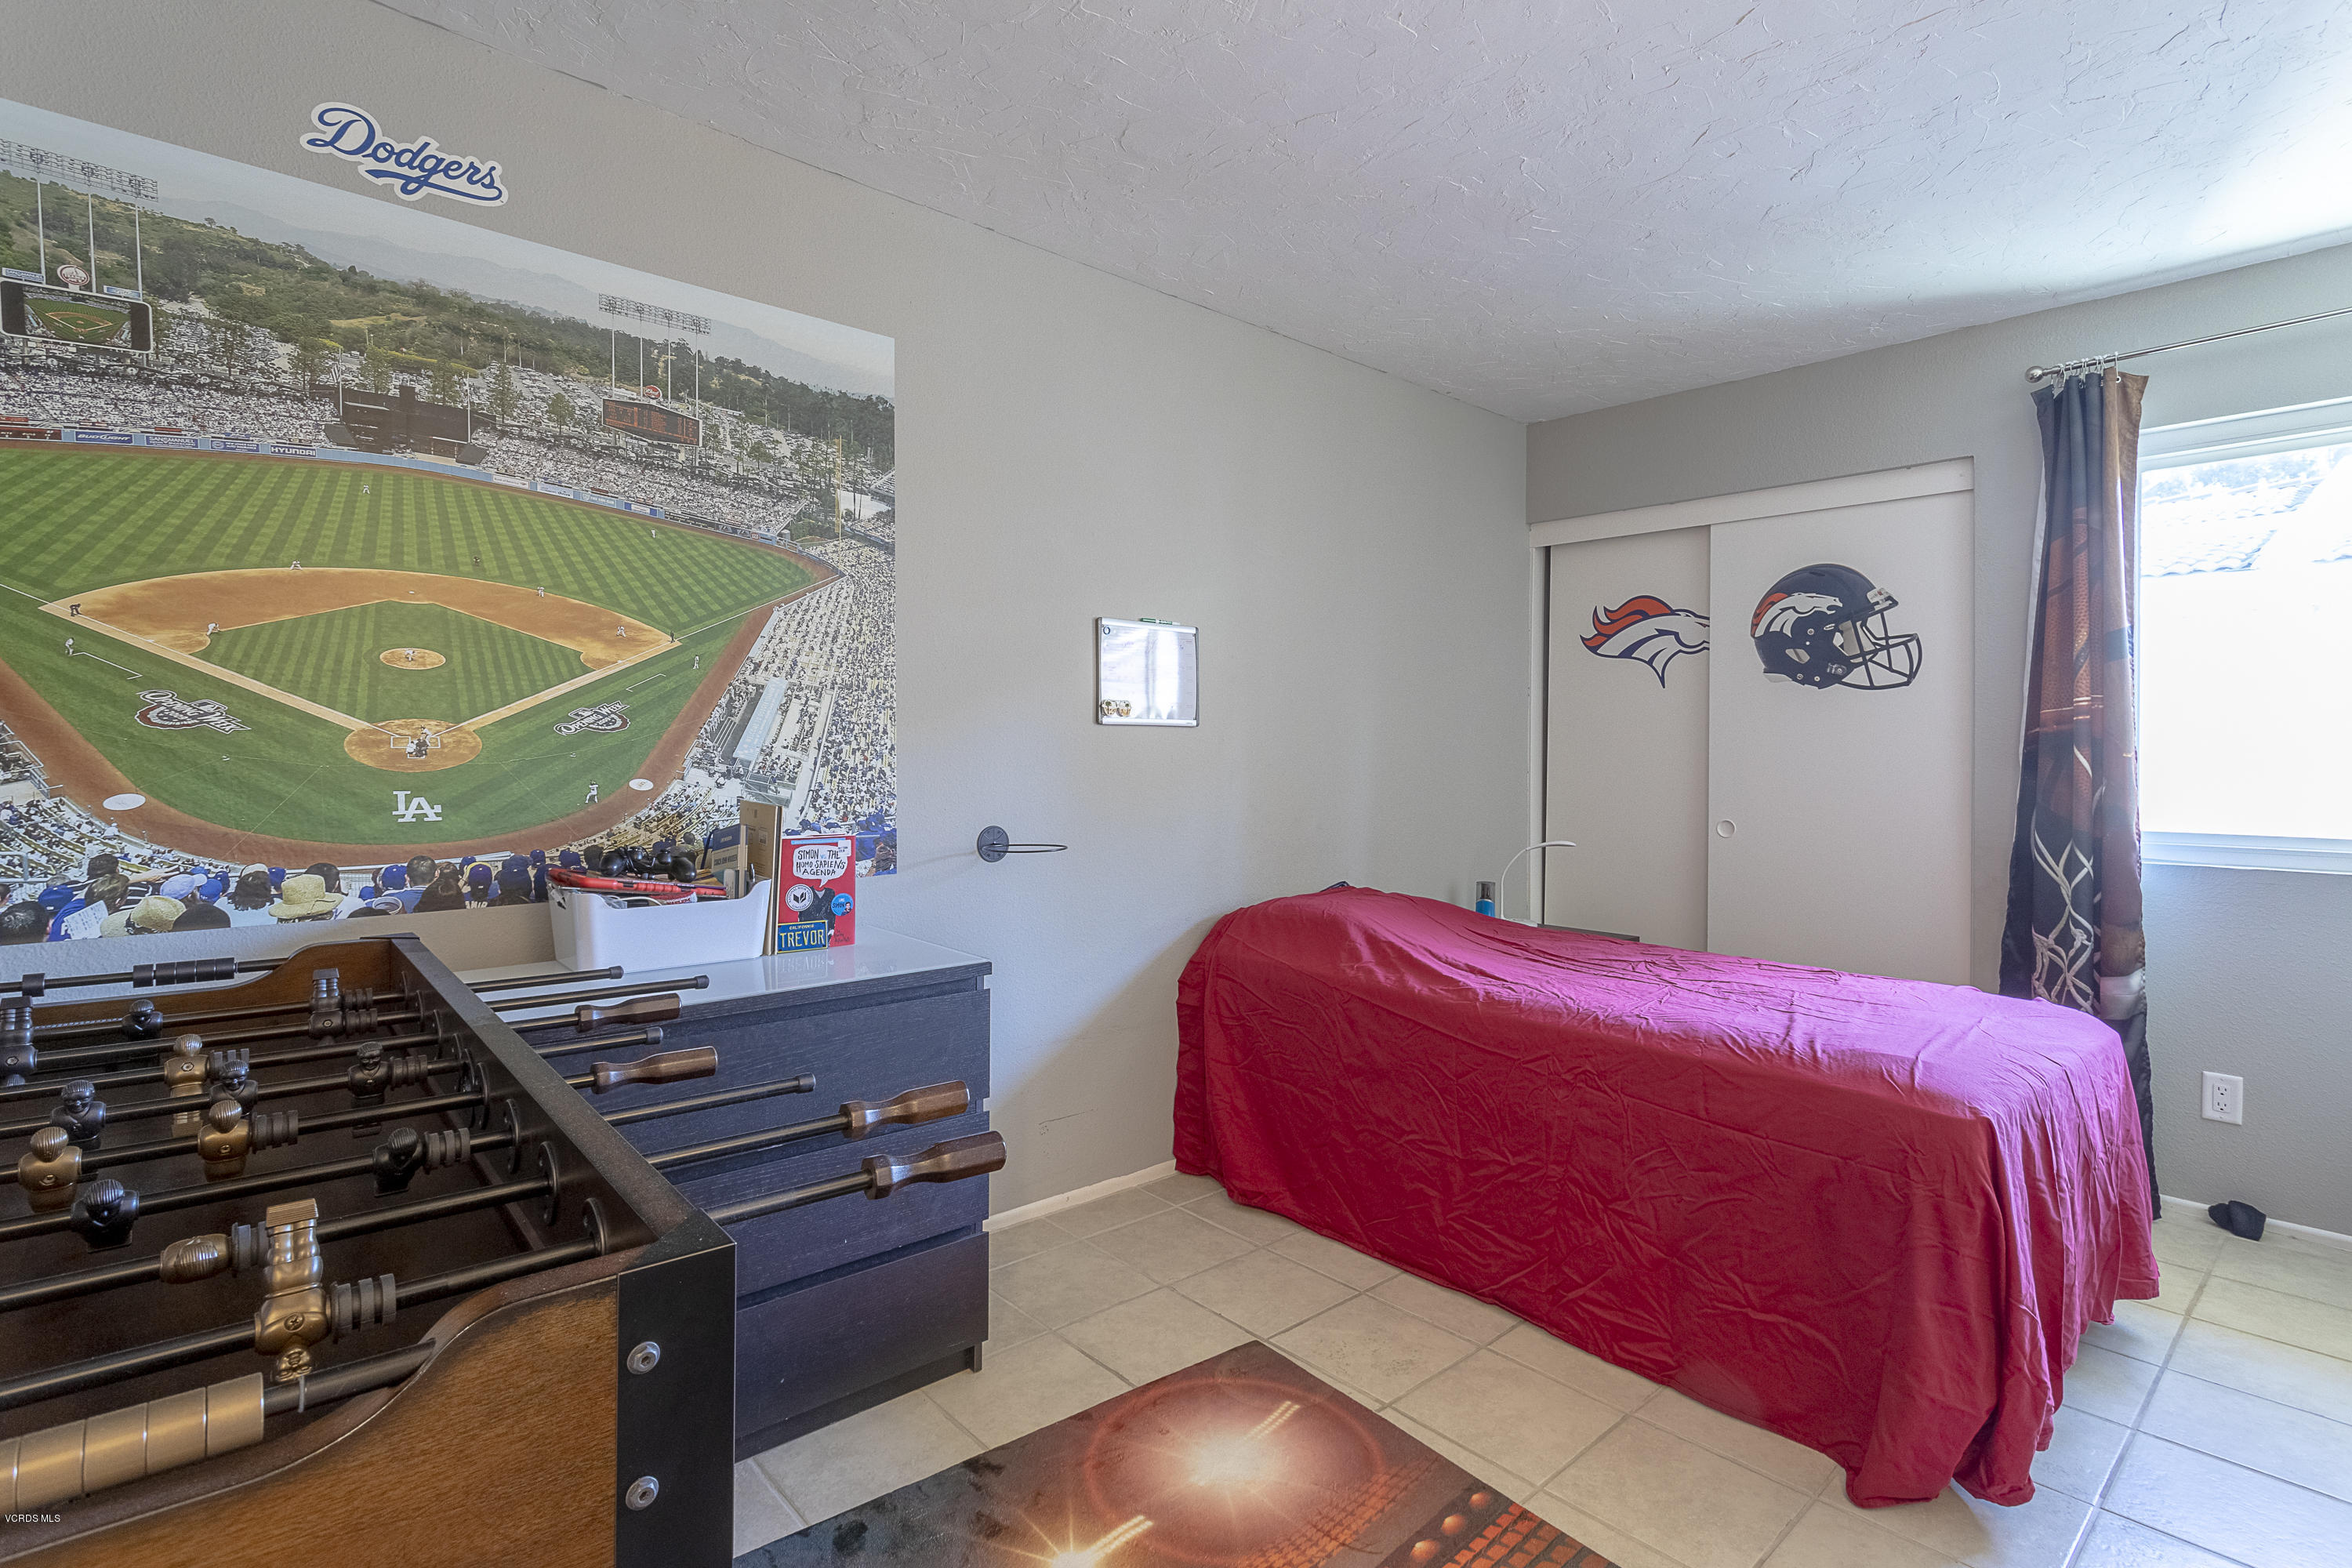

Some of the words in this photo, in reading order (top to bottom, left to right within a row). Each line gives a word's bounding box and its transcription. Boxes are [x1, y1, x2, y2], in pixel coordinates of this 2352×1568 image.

[307, 108, 503, 201] Dodgers
[271, 446, 315, 456] HYUNDAI
[392, 790, 443, 822] LA
[797, 848, 819, 860] SIMON
[827, 849, 840, 859] THE
[796, 861, 813, 873] HOMO
[815, 859, 846, 869] SAPIENS
[780, 929, 825, 948] TREVOR
